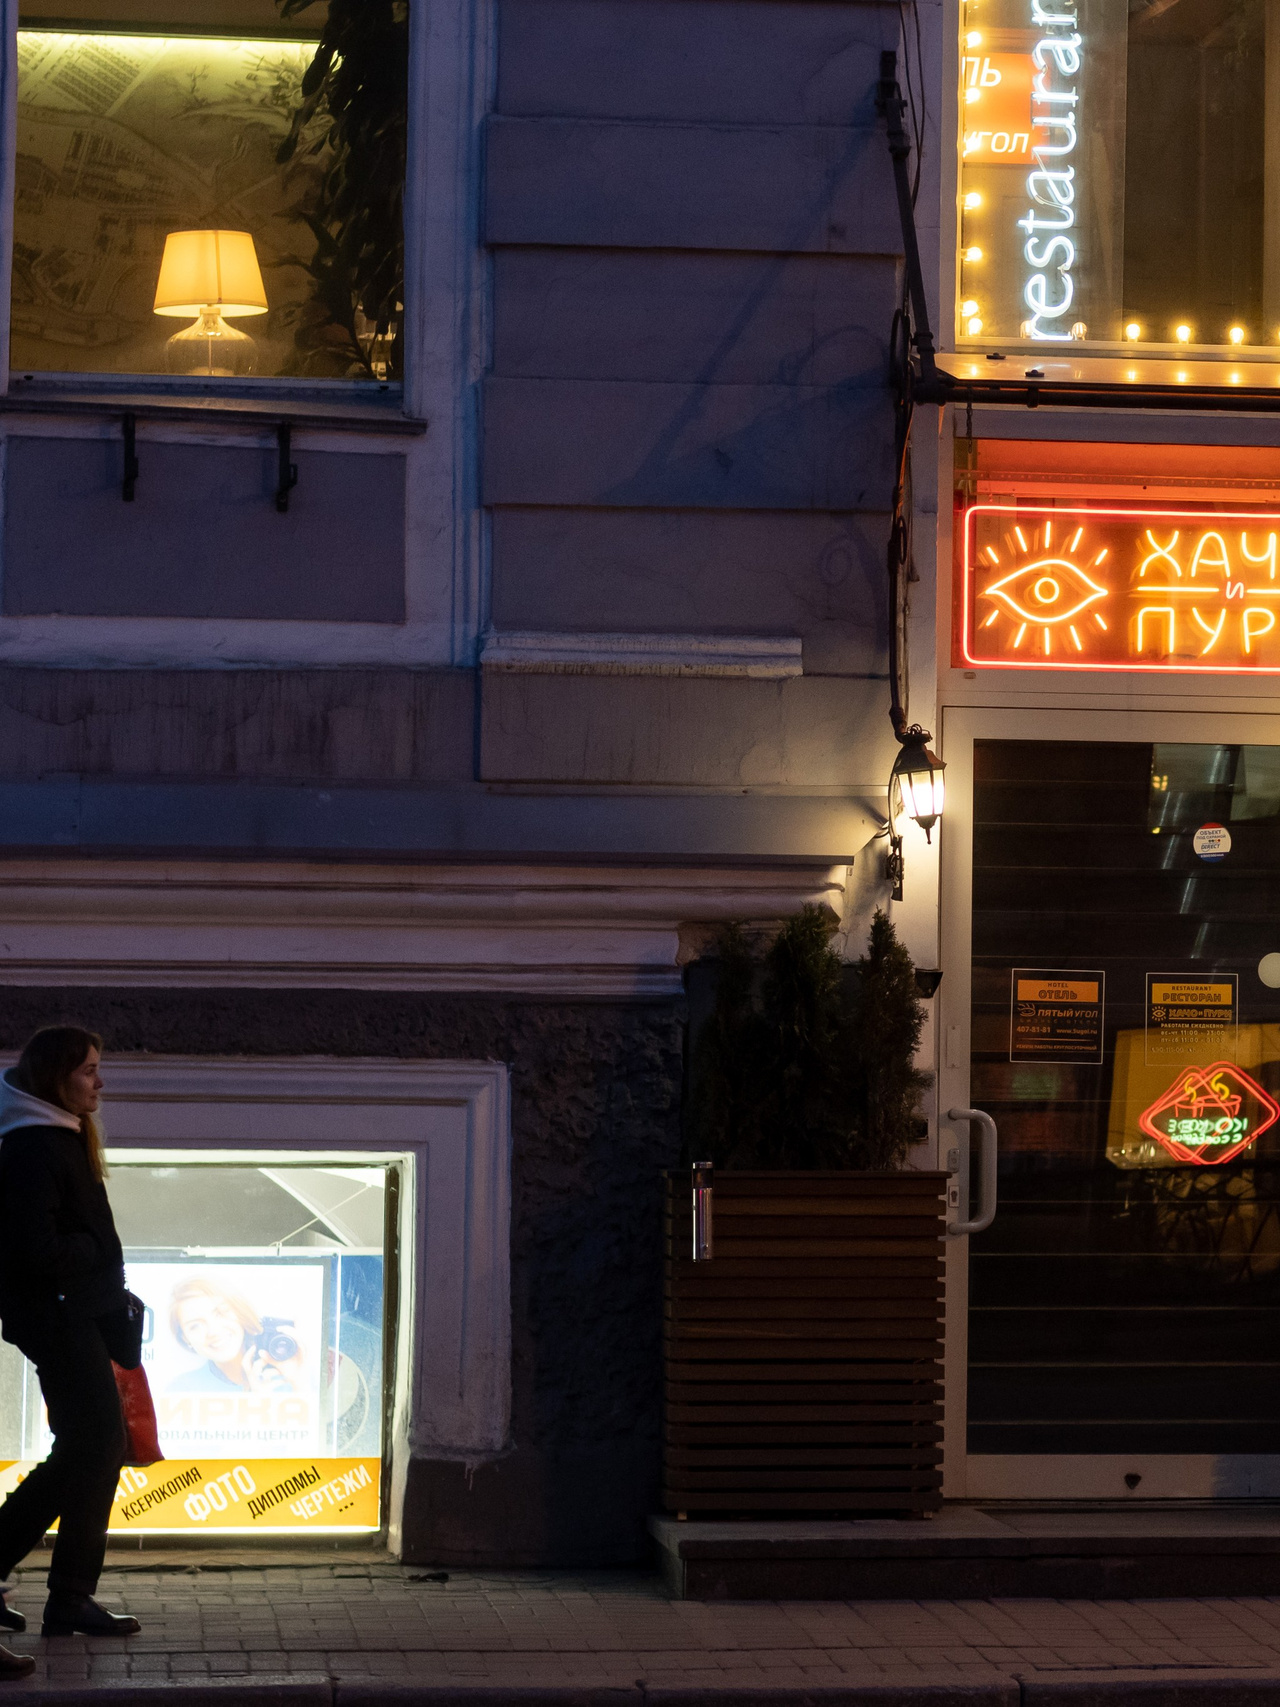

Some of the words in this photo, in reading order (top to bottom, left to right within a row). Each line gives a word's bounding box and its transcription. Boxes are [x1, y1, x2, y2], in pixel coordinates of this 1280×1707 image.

[1038, 989, 1078, 1000] ОТЕЛЬ
[1162, 993, 1222, 1002] РЕСТОРАН
[1037, 1008, 1074, 1018] ПЯТЫЙ
[1074, 1010, 1099, 1018] УГОЛ
[1168, 1008, 1198, 1018] ХАЧО
[1203, 1009, 1233, 1019] ПУРИ
[1016, 1026, 1052, 1034] 407-81-81
[159, 1397, 311, 1427] ИРКА
[159, 1430, 252, 1441] ОВАЛЬНЫЙ
[255, 1430, 310, 1442] ЦЕНТР
[114, 1465, 149, 1503] АТЬ
[120, 1466, 203, 1521] КСЕРОКОПИЯ
[183, 1465, 257, 1522] ФОТО
[246, 1465, 322, 1520] ДИПЛОМЫ
[289, 1464, 373, 1520] ЧЕРТЕЖИ
